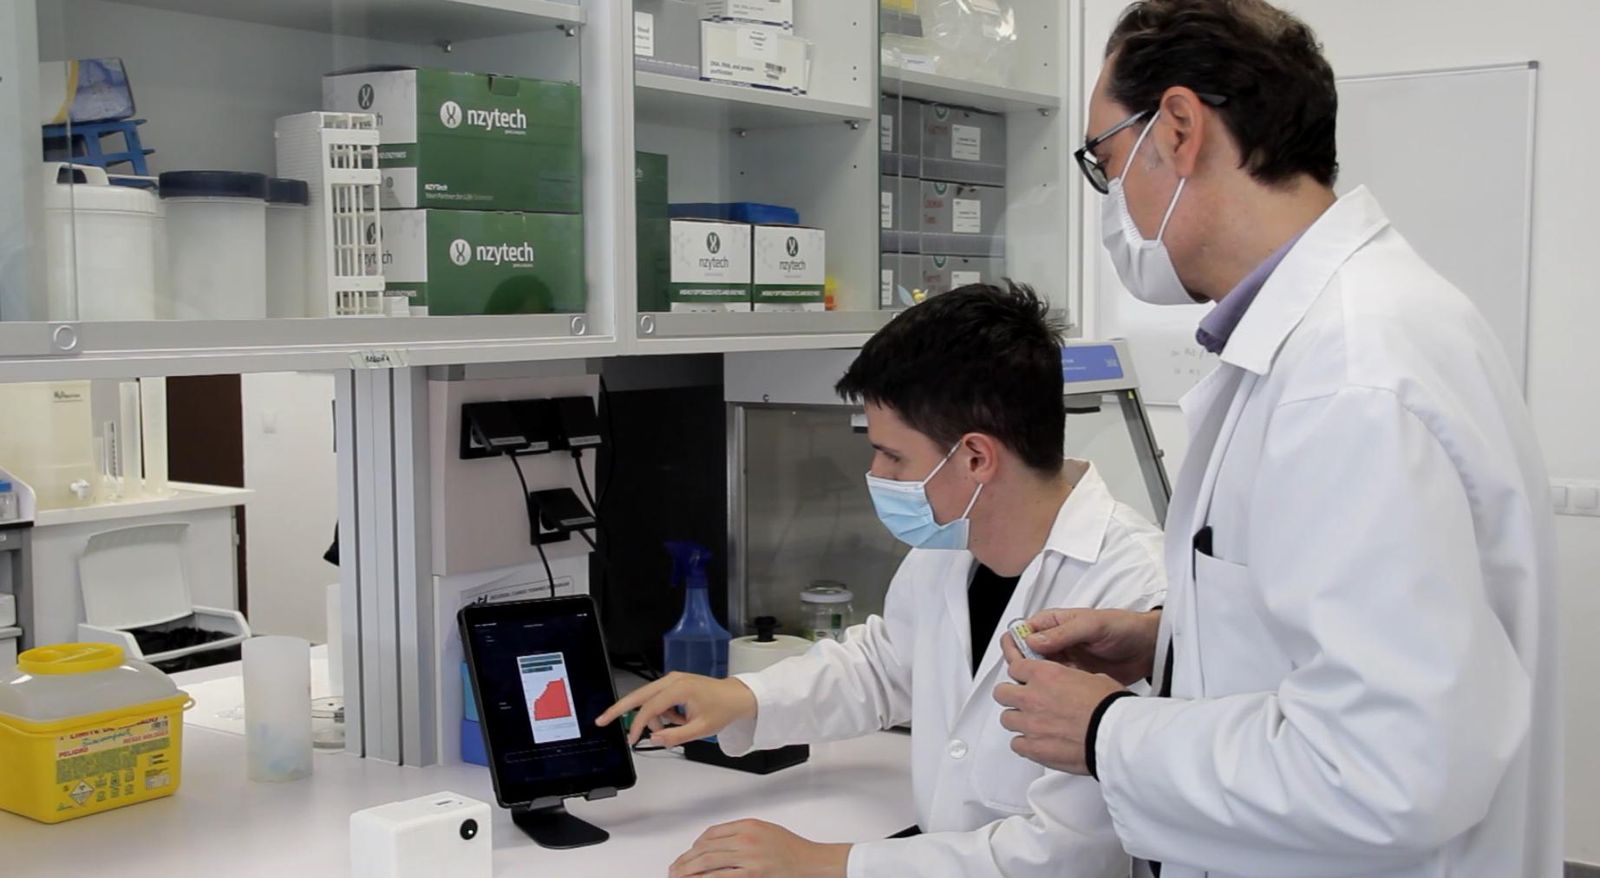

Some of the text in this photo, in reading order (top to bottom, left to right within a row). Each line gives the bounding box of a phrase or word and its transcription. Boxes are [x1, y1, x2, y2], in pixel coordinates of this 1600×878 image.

[467, 109, 527, 131] nzytech
[476, 242, 534, 265] nzytech
[699, 256, 729, 270] nzytech
[779, 259, 806, 273] nzytech
